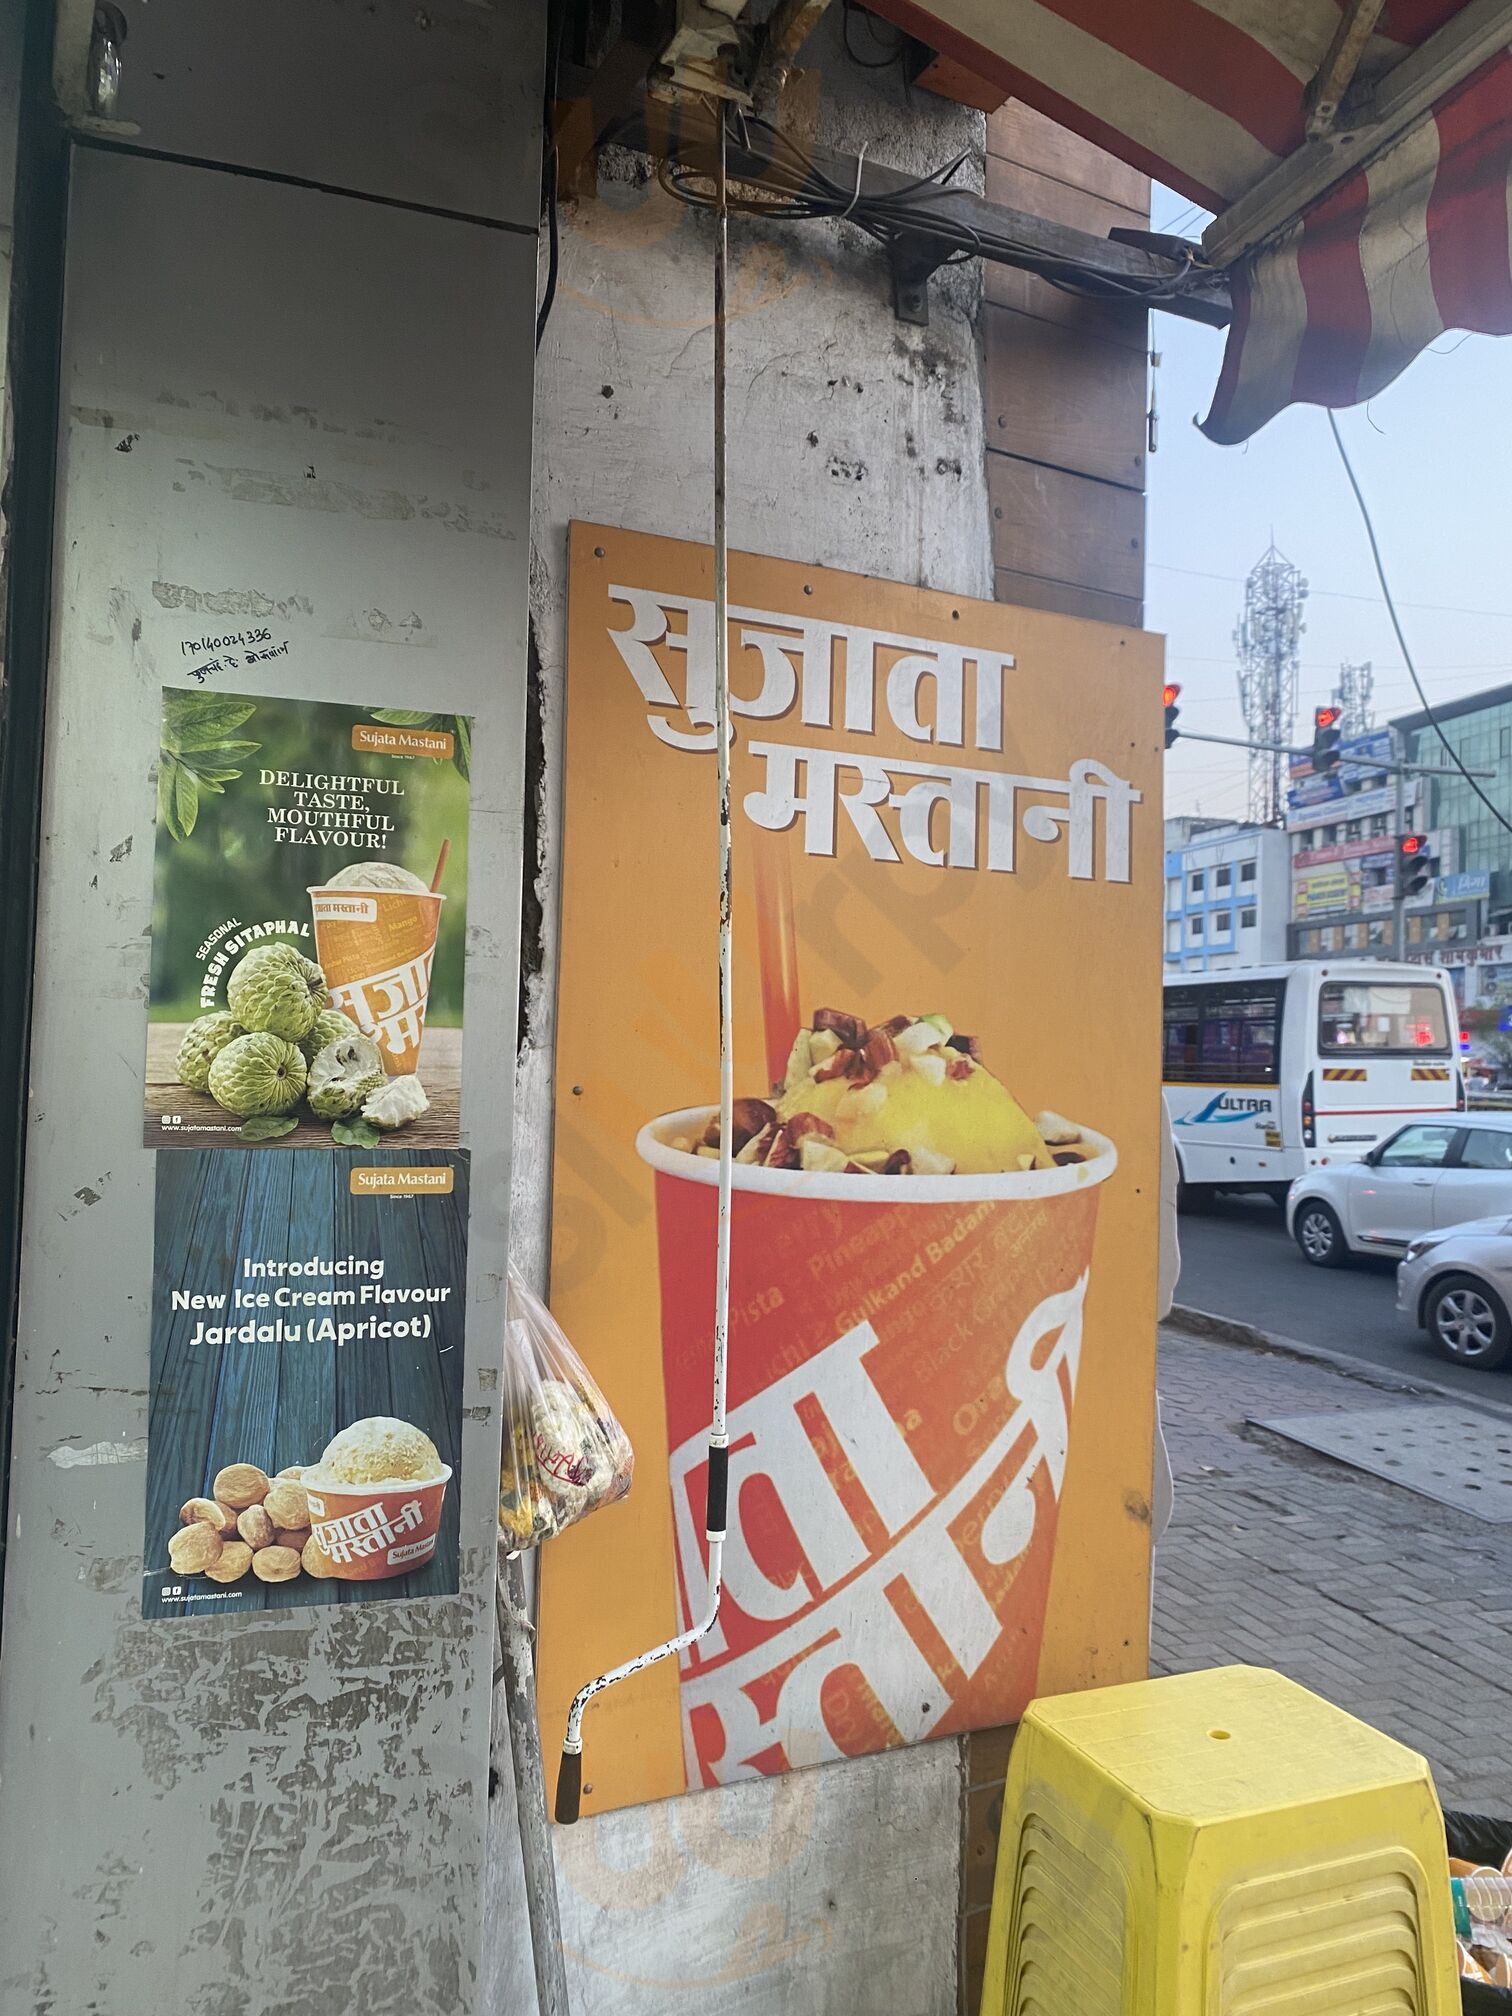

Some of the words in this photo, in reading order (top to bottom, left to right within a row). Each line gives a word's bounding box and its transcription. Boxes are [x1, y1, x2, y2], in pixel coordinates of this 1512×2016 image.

[607, 583, 1018, 754] सुजाता
[359, 730, 396, 747] Sujata
[398, 734, 447, 751] Mastani
[259, 769, 406, 797] DELIGHTFUL
[294, 791, 371, 813] TASTE,
[743, 740, 1142, 884] मस्तानी
[266, 807, 396, 833] MOUTHFUL
[273, 827, 388, 850] FLAVOUR!
[195, 917, 243, 962] SEASONAL
[200, 952, 229, 1009] FRESH
[224, 919, 311, 956] SITAPHAL
[1218, 1098, 1272, 1113] ULTRA
[161, 1125, 242, 1133] www.sujatamastani.com
[358, 1172, 395, 1189] Sujata
[397, 1172, 446, 1185] Mastani
[243, 1255, 385, 1280] Introducing
[833, 1251, 929, 1337] Gulkand
[925, 1199, 997, 1266] Badam
[171, 1290, 227, 1311] New
[235, 1288, 271, 1309] Ice
[274, 1287, 356, 1308] Cream
[360, 1284, 451, 1305] Flavour
[189, 1318, 302, 1347] Jardalu
[306, 1314, 433, 1348] (Apricot)
[330, 1499, 425, 1564] मस्तानी
[161, 1591, 243, 1604] www.sujatamastani.com
